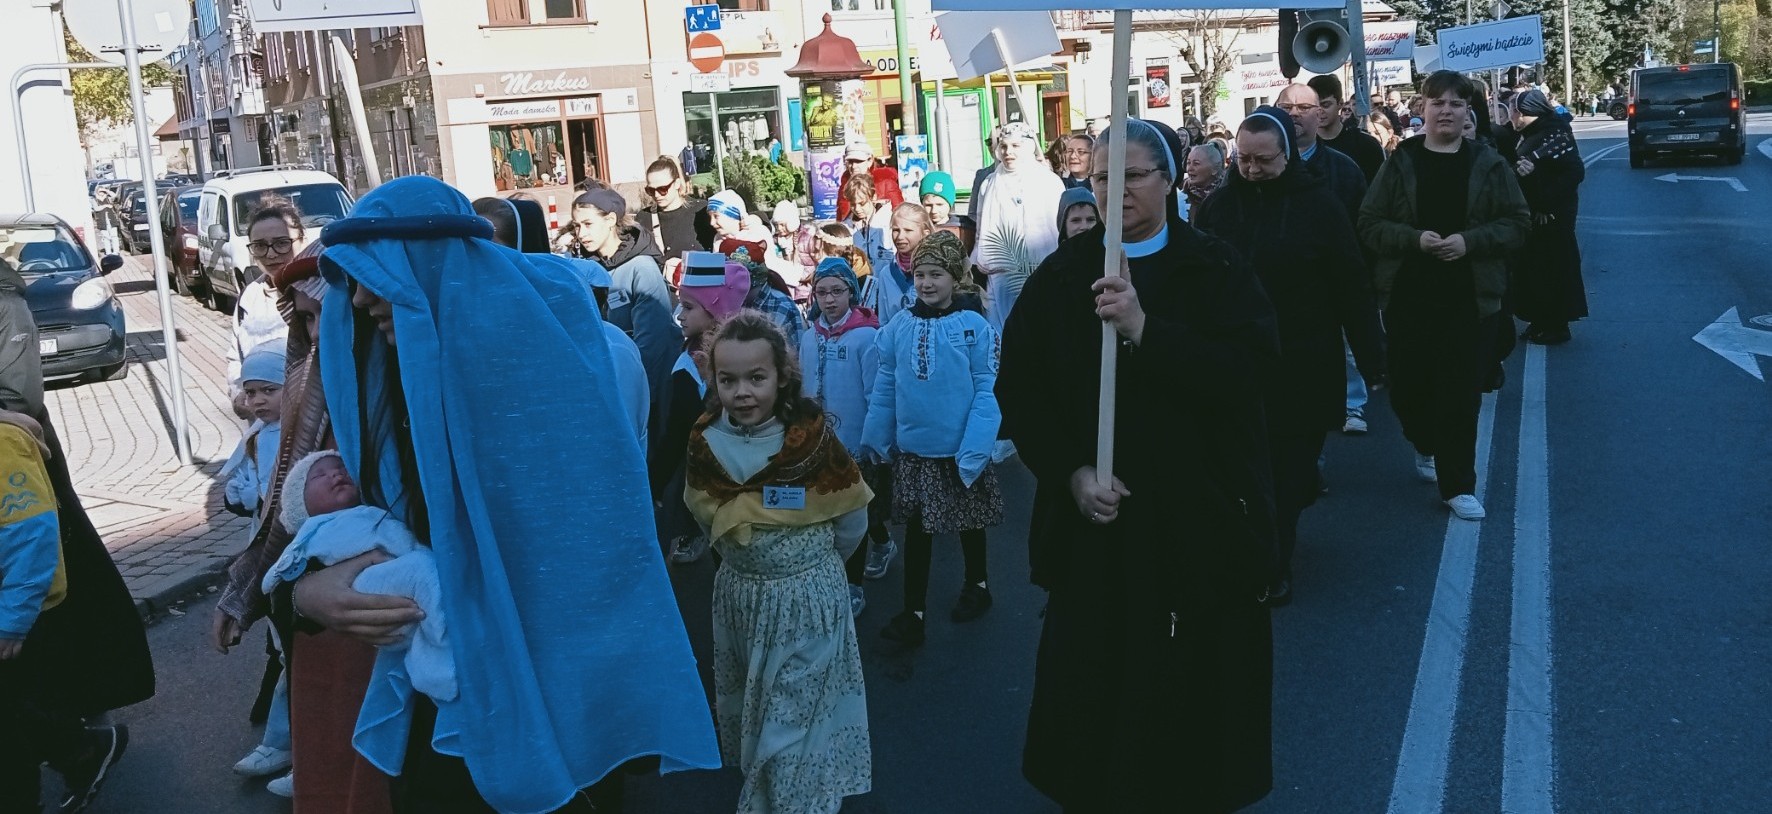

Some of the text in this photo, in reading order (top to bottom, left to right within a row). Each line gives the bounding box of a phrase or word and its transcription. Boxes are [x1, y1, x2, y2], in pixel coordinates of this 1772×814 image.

[1378, 32, 1410, 44] naszym
[1447, 33, 1534, 58] Świętymi bądźcie
[501, 71, 589, 94] Markus
[491, 105, 556, 117] Moda damska
